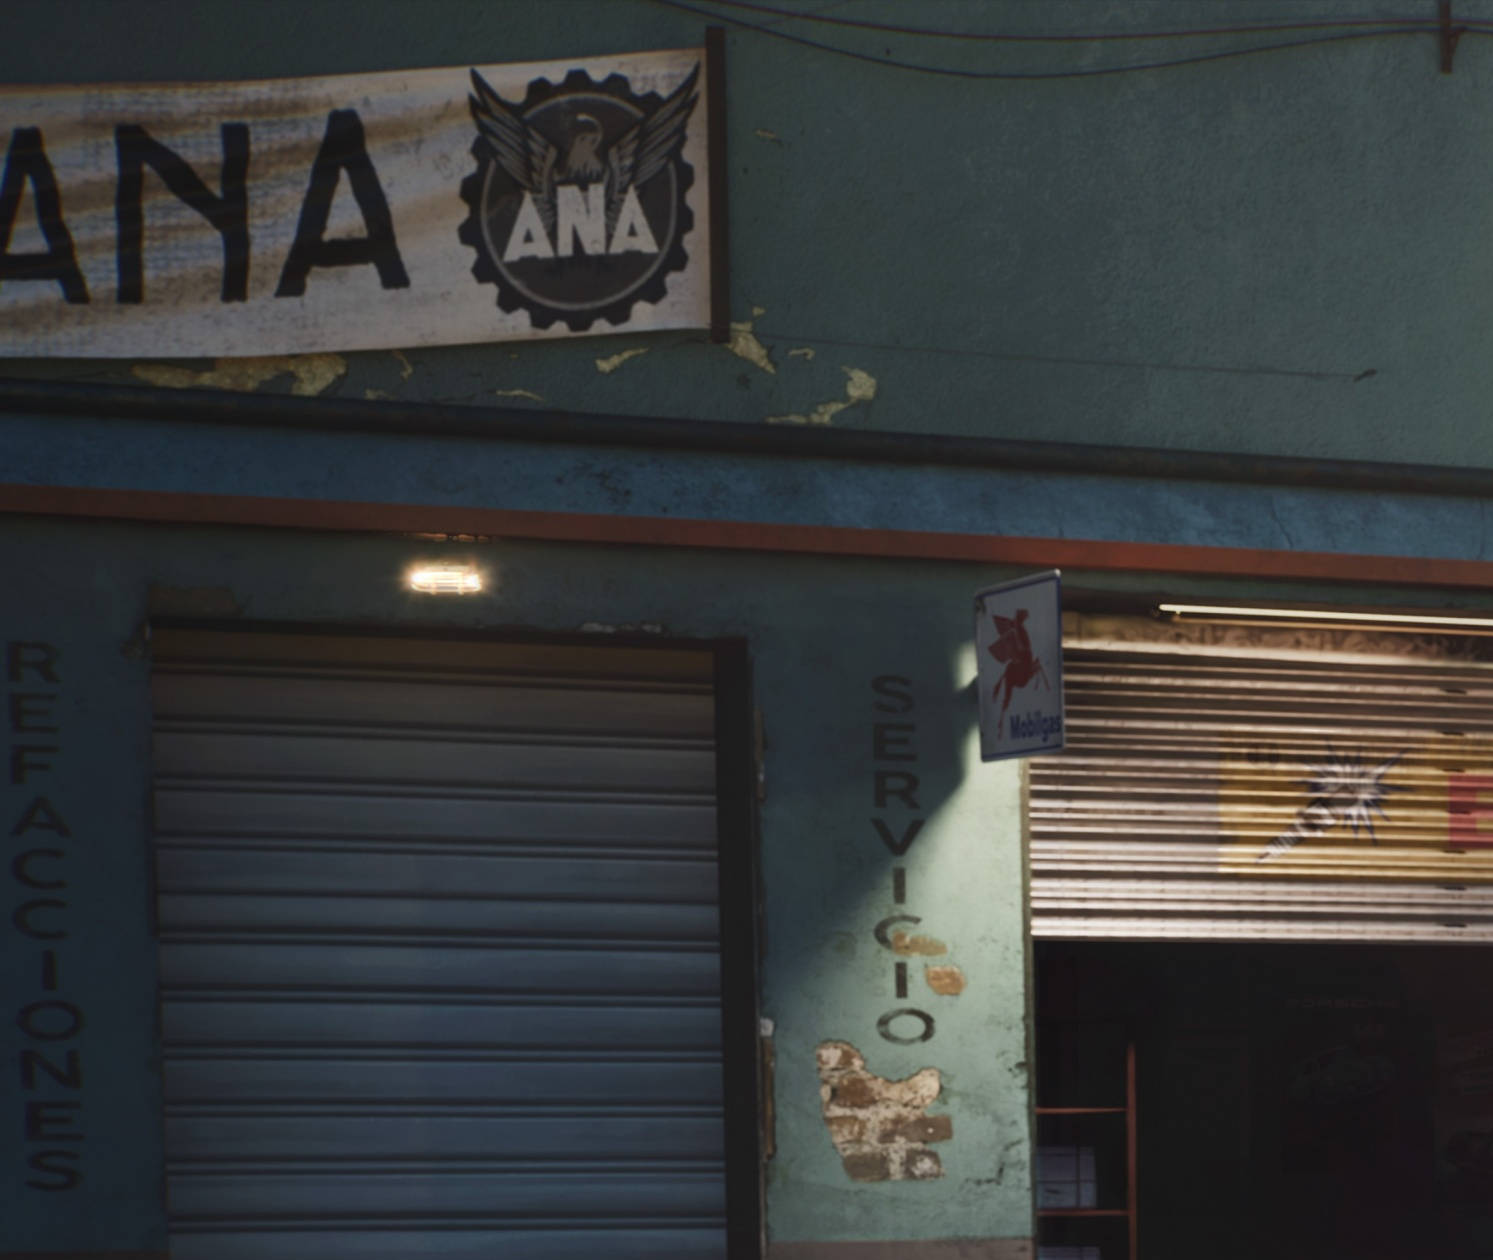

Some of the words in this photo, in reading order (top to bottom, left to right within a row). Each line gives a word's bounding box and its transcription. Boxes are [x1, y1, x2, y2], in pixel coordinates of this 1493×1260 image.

[0, 108, 411, 303] ANA
[502, 182, 660, 263] ANA
[1008, 709, 1062, 743] Mobilgas
[6, 639, 85, 1194] REFACCIONES
[870, 673, 936, 1046] SERVICIO
